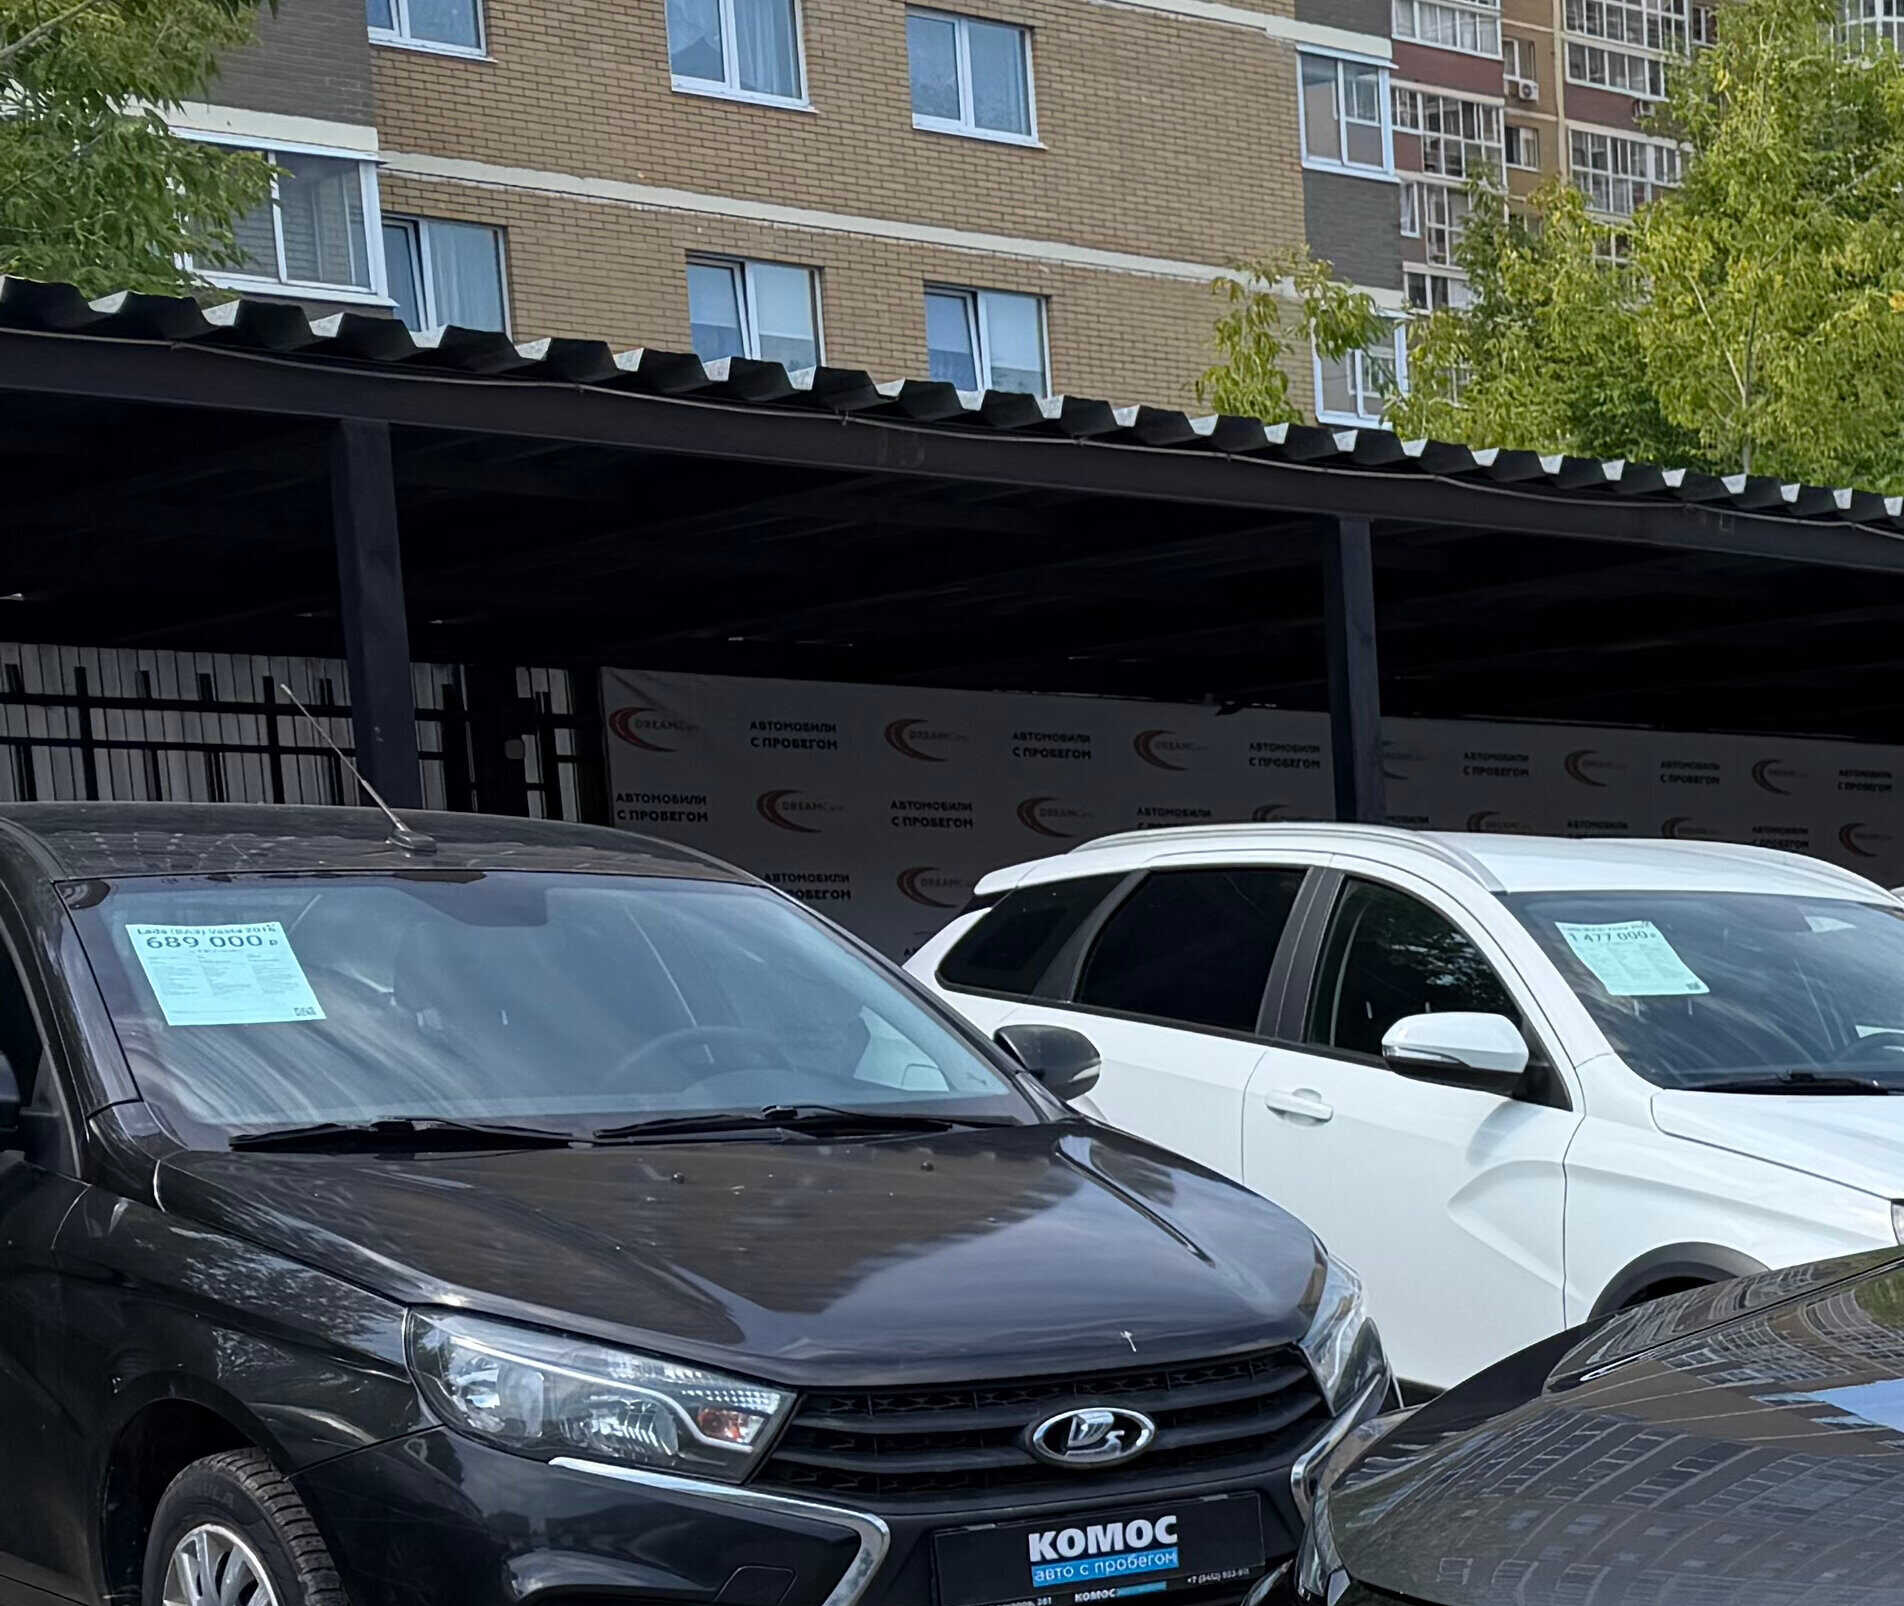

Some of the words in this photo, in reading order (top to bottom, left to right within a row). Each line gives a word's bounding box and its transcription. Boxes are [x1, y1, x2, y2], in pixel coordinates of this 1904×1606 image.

[749, 720, 837, 734] АВТОМОБИЛИ
[750, 737, 761, 749] С
[762, 737, 838, 751] ПРОБЕГОМ
[1012, 731, 1092, 744] АВТОМОБИЛИ
[1012, 747, 1022, 758] С
[1023, 747, 1092, 760] ПРОБЕГОМ
[616, 792, 708, 806] АВТОМОБИЛИ
[890, 800, 973, 812] АВТОМОБИЛИ
[617, 809, 628, 821] С
[629, 809, 709, 823] ПРОБЕГОМ
[891, 815, 901, 827] С
[902, 816, 974, 829] ПРОБЕГОМ
[146, 936, 200, 949] 689
[209, 935, 263, 948] 000
[1617, 930, 1649, 941] 000
[1028, 1515, 1178, 1562] КОМОС
[1034, 1564, 1075, 1582] авто
[1079, 1564, 1090, 1577] с
[1094, 1552, 1177, 1574] пробегом
